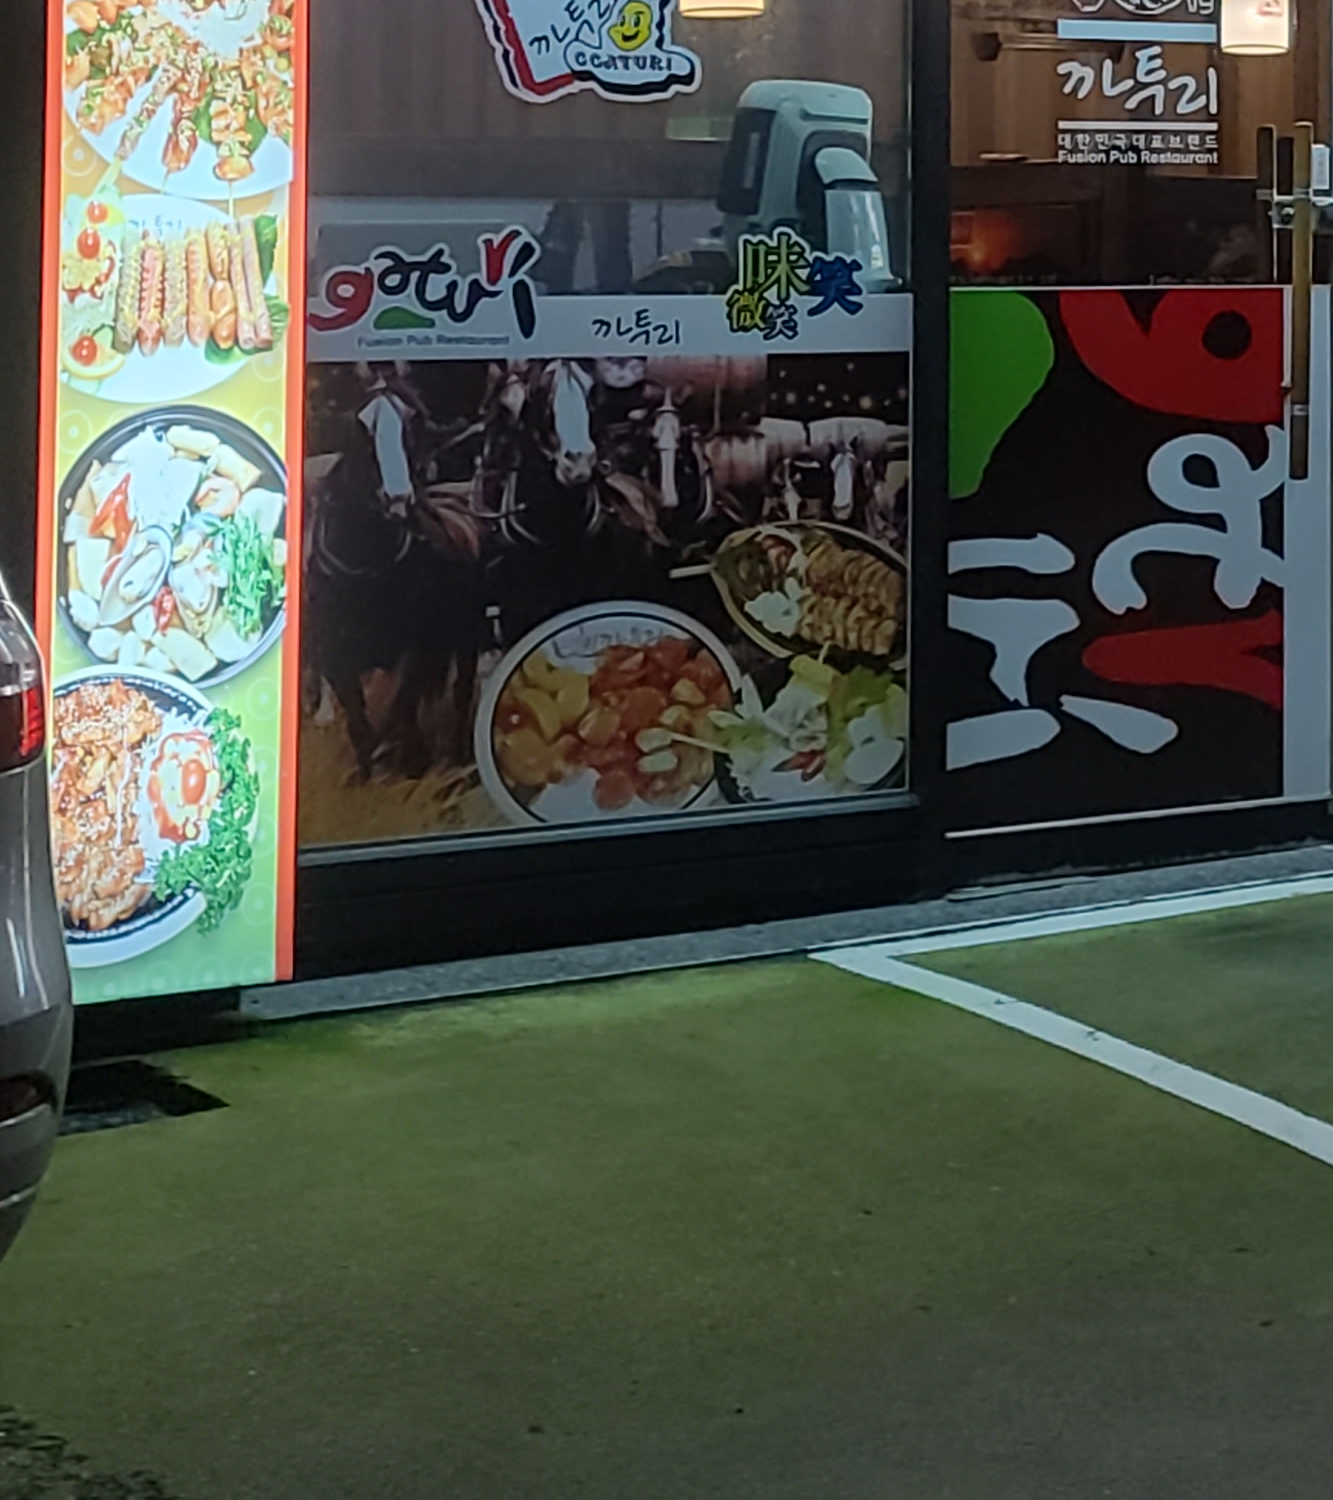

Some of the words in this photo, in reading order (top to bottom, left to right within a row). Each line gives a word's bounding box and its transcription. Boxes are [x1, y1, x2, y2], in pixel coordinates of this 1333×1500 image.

[1056, 45, 1218, 116] 까투리
[1057, 150, 1106, 164] Fusion
[1109, 150, 1138, 164] Pub
[1140, 151, 1219, 164] Restaurant
[592, 306, 681, 347] 까투리
